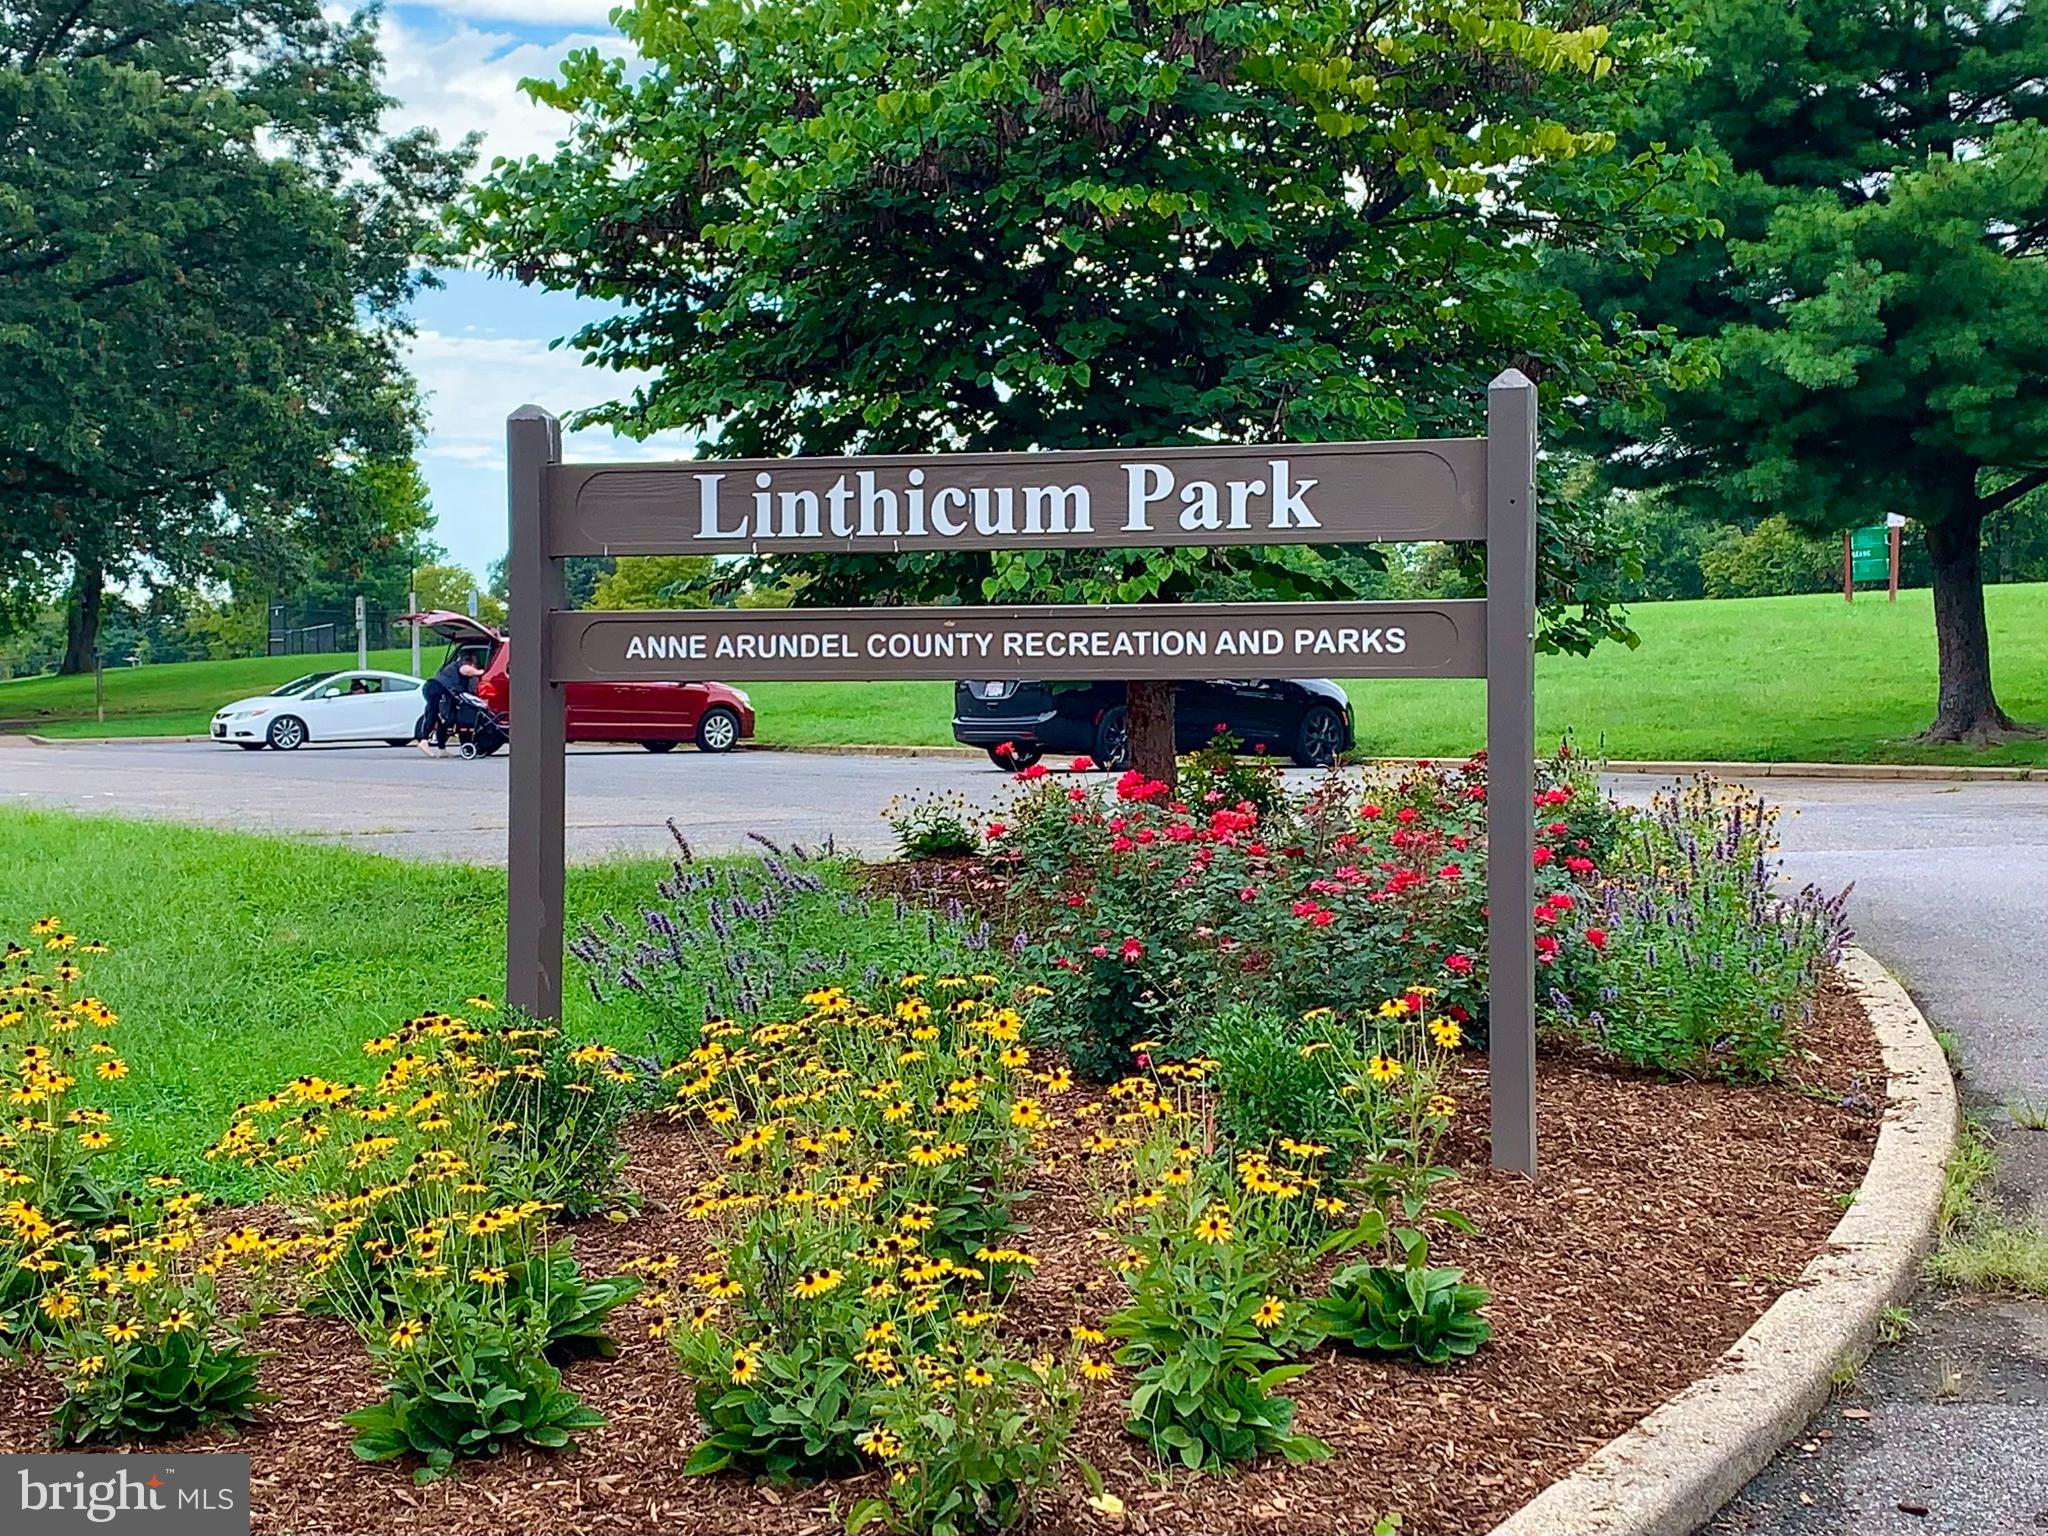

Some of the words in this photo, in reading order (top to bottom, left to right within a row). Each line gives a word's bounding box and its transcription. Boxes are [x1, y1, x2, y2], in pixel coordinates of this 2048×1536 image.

[692, 467, 1095, 539] Linthicum
[1119, 459, 1323, 532] Park
[625, 635, 707, 660] ANNE
[714, 633, 859, 659] ARUNDEL
[866, 632, 994, 659] COUNTY
[1003, 629, 1207, 658] RECREATION
[1213, 629, 1285, 656] AND
[1294, 627, 1408, 655] PARKS
